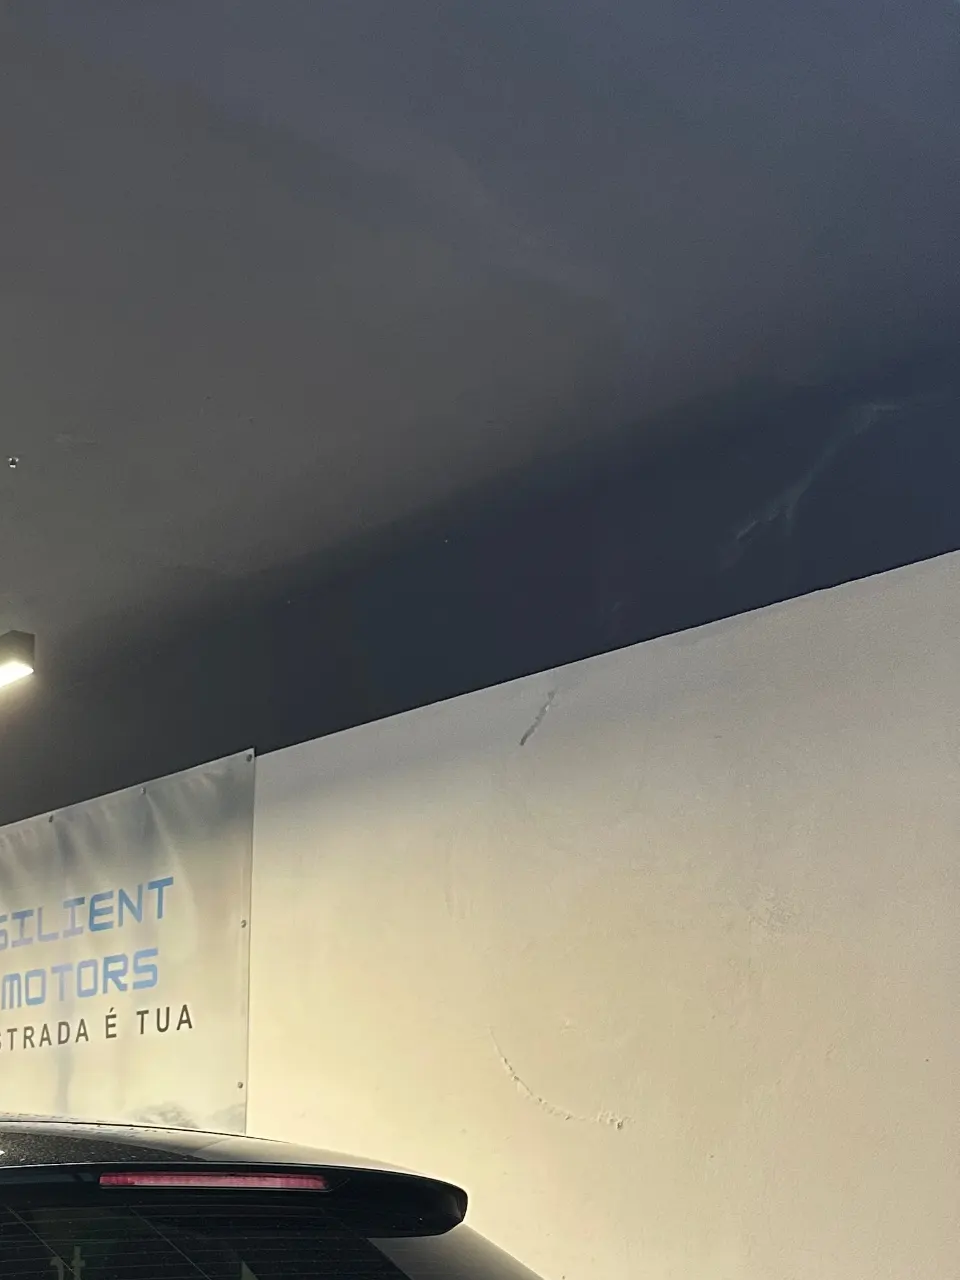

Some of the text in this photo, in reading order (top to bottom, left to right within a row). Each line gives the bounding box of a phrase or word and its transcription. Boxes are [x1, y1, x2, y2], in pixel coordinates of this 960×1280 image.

[1, 948, 158, 1010] MOTORS
[105, 1007, 118, 1039] É
[136, 1004, 194, 1035] TUA
